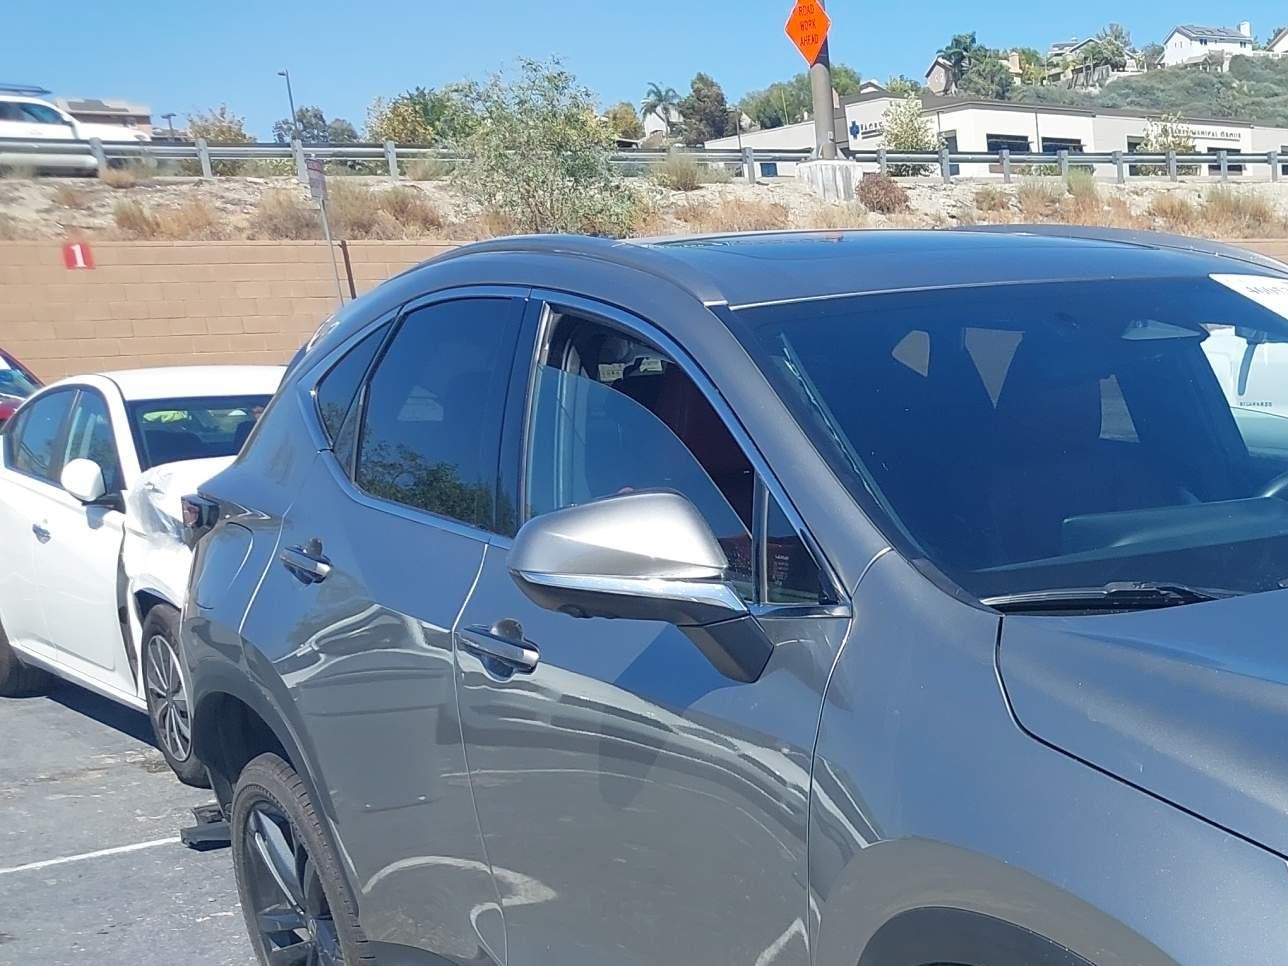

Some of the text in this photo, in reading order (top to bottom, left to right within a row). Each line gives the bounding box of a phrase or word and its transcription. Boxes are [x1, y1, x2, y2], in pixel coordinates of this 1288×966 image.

[798, 4, 815, 16] ROAD
[800, 18, 817, 31] WORK
[799, 34, 819, 46] AHEAD
[69, 244, 87, 268] 1
